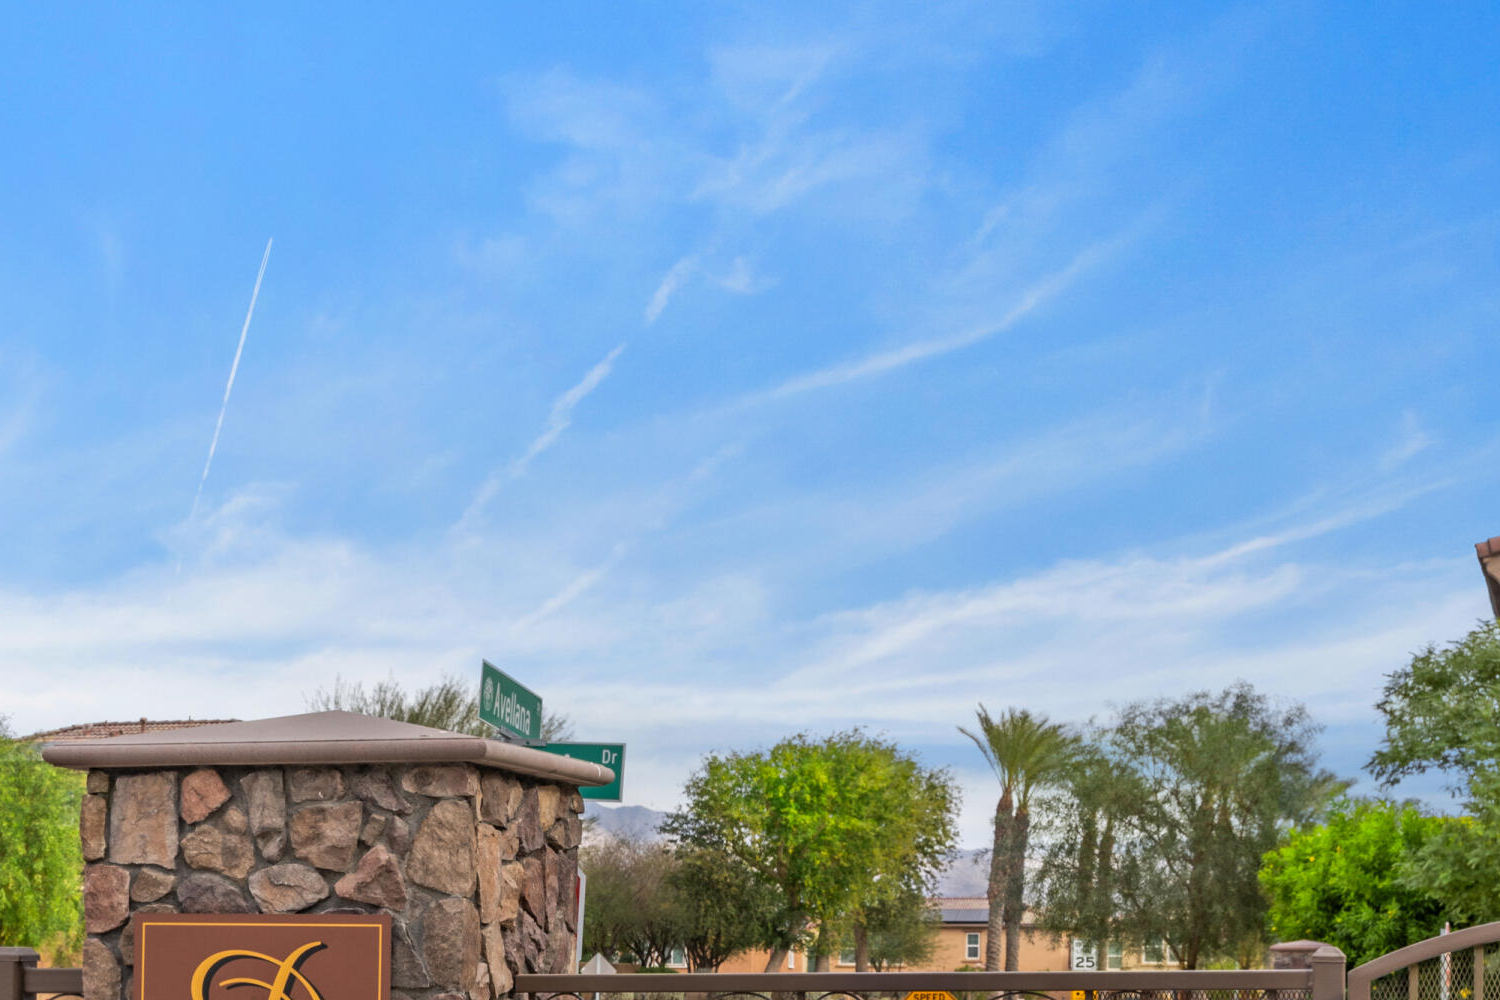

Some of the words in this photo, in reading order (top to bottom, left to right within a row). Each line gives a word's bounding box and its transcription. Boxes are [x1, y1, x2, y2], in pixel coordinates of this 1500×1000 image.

[493, 682, 531, 735] Avellana
[602, 749, 617, 764] Dr
[1076, 957, 1095, 968] 25
